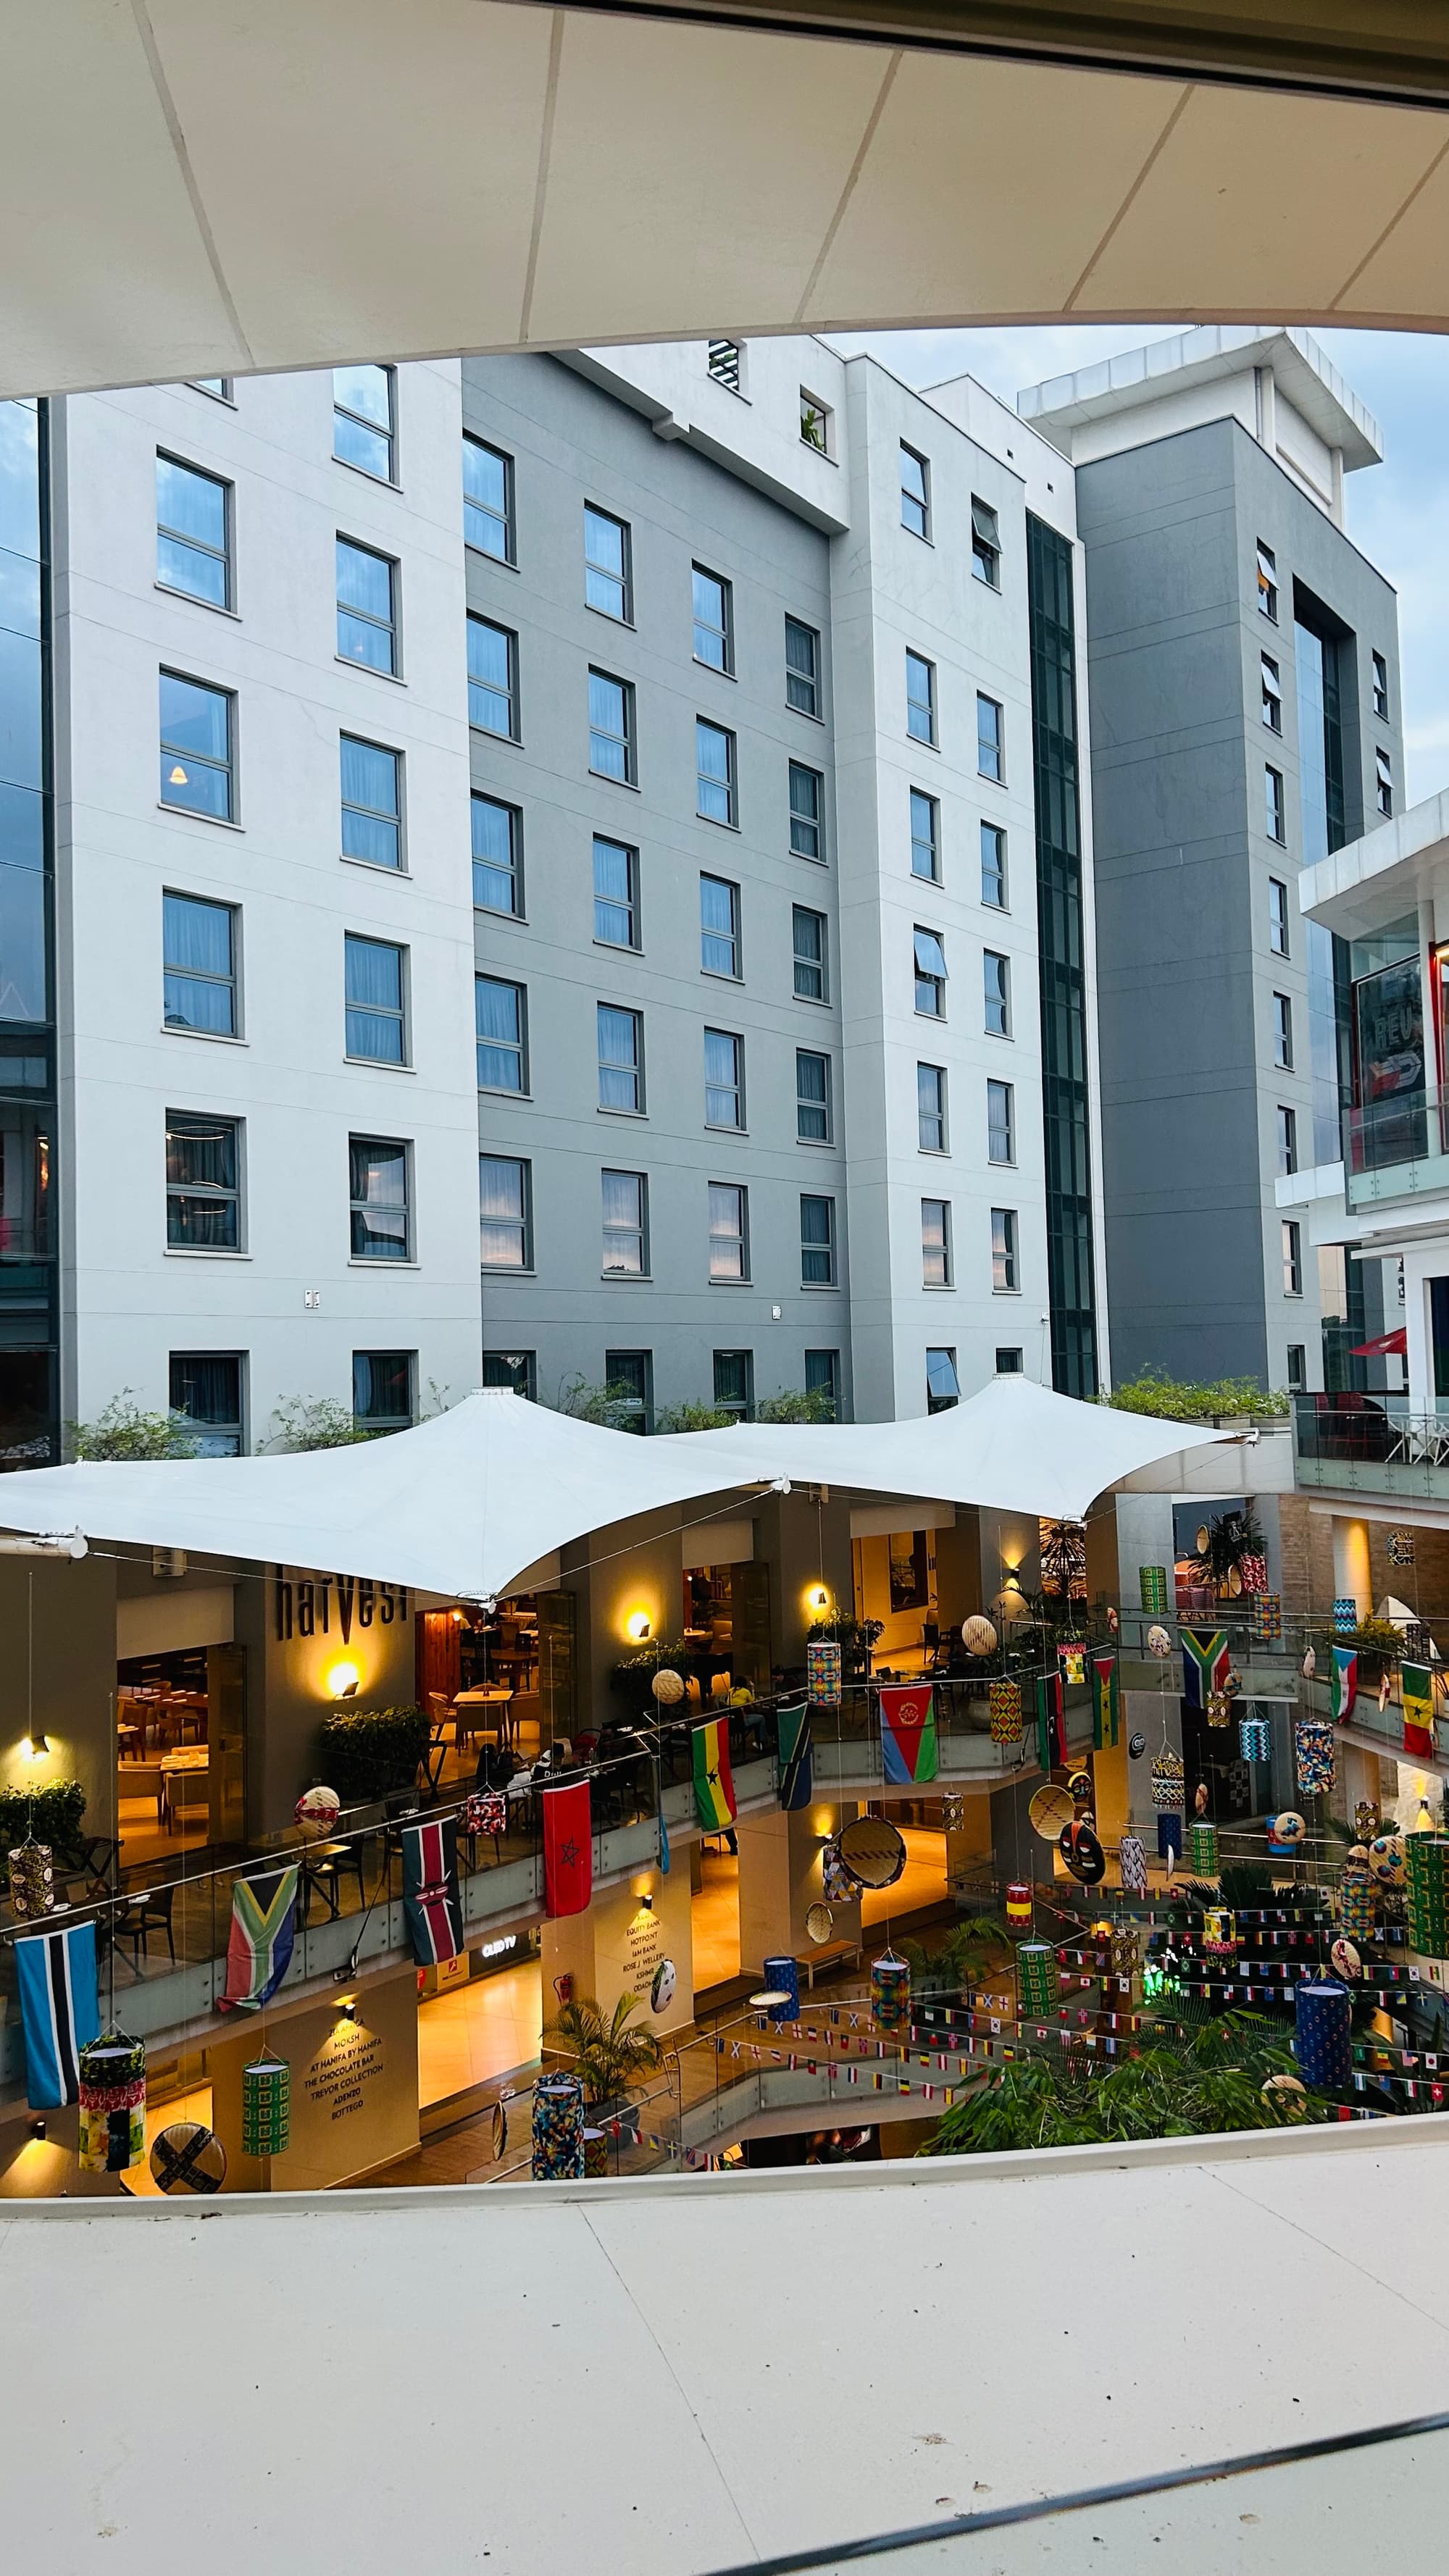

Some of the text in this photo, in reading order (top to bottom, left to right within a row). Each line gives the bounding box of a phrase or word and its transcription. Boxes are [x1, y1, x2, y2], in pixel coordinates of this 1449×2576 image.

[627, 1918, 661, 1936] EQUITY BANK
[504, 1935, 517, 1949] TV
[630, 1931, 658, 1946] HOTPOINT
[643, 1944, 656, 1954] BANK
[623, 1962, 636, 1972] ROSE
[334, 2033, 359, 2049] MOKSH
[310, 2037, 382, 2073] AT HANIFA BY HANIFA
[304, 2054, 375, 2088] THE CHOCOLATE BAR
[312, 2063, 383, 2101] TREVOR COLLECTION
[332, 2099, 363, 2120] BOTTEGO
